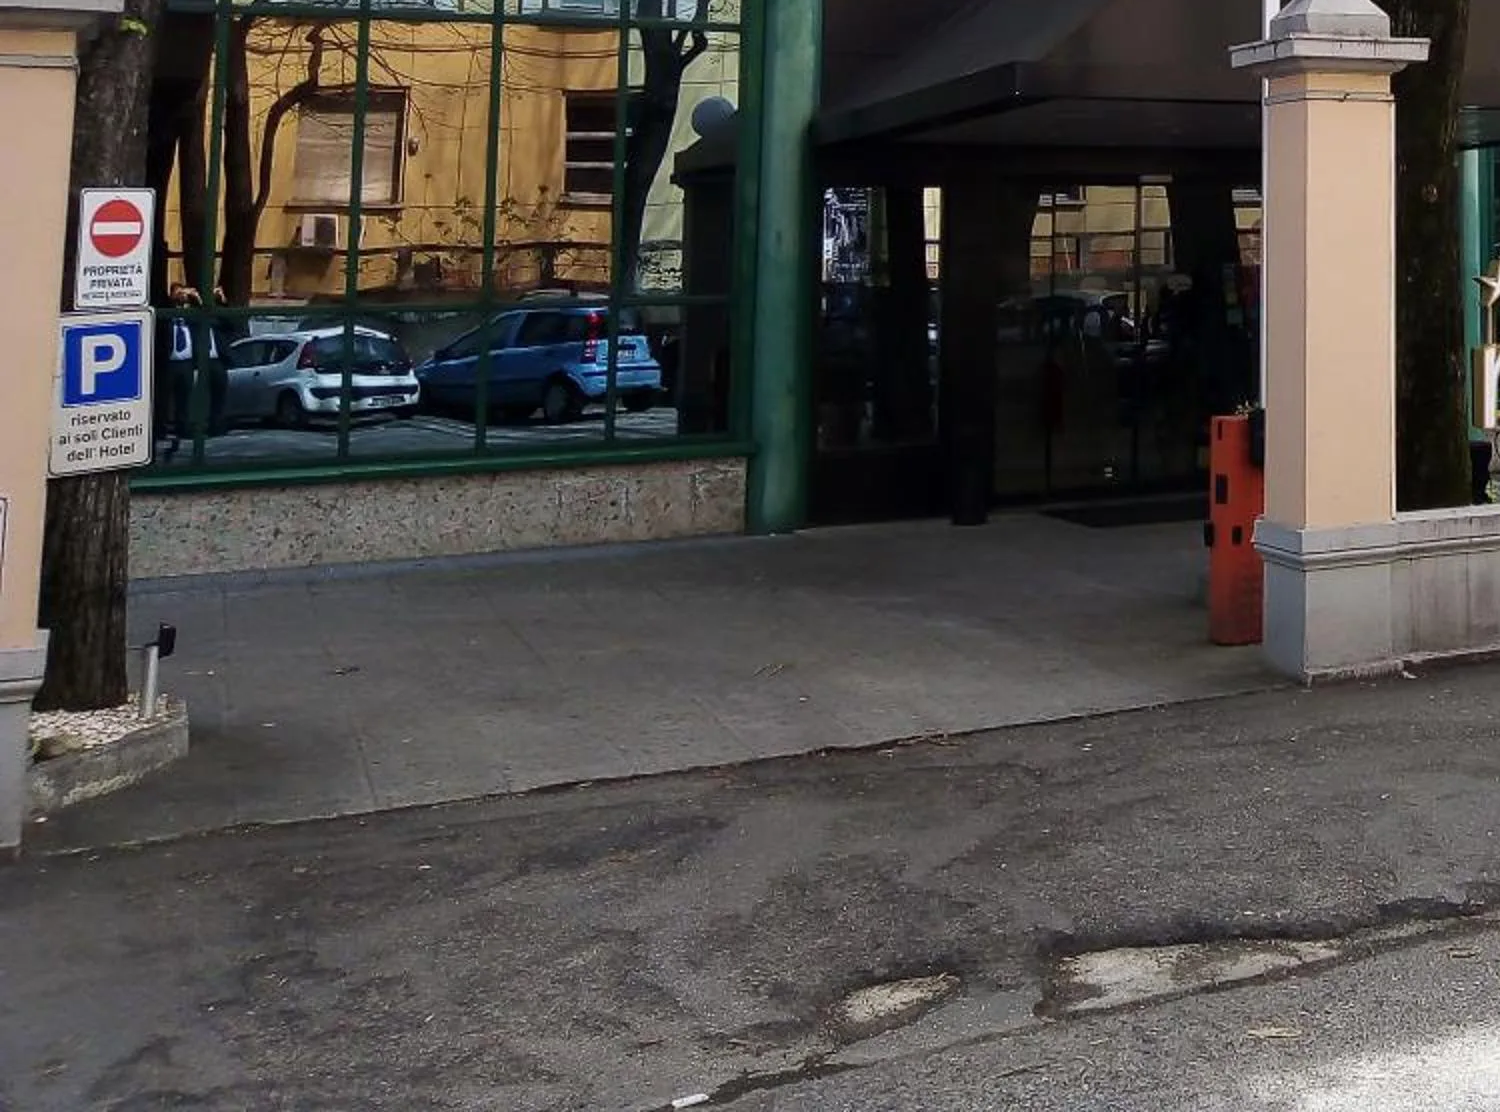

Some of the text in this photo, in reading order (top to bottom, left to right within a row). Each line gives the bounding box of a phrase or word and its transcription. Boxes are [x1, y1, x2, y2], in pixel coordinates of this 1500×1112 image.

[89, 277, 133, 290] PRIVATA
[80, 333, 127, 395] P
[71, 409, 131, 426] riservato
[73, 429, 98, 443] soli
[101, 423, 143, 440] Clienti
[99, 442, 135, 458] Hotel
